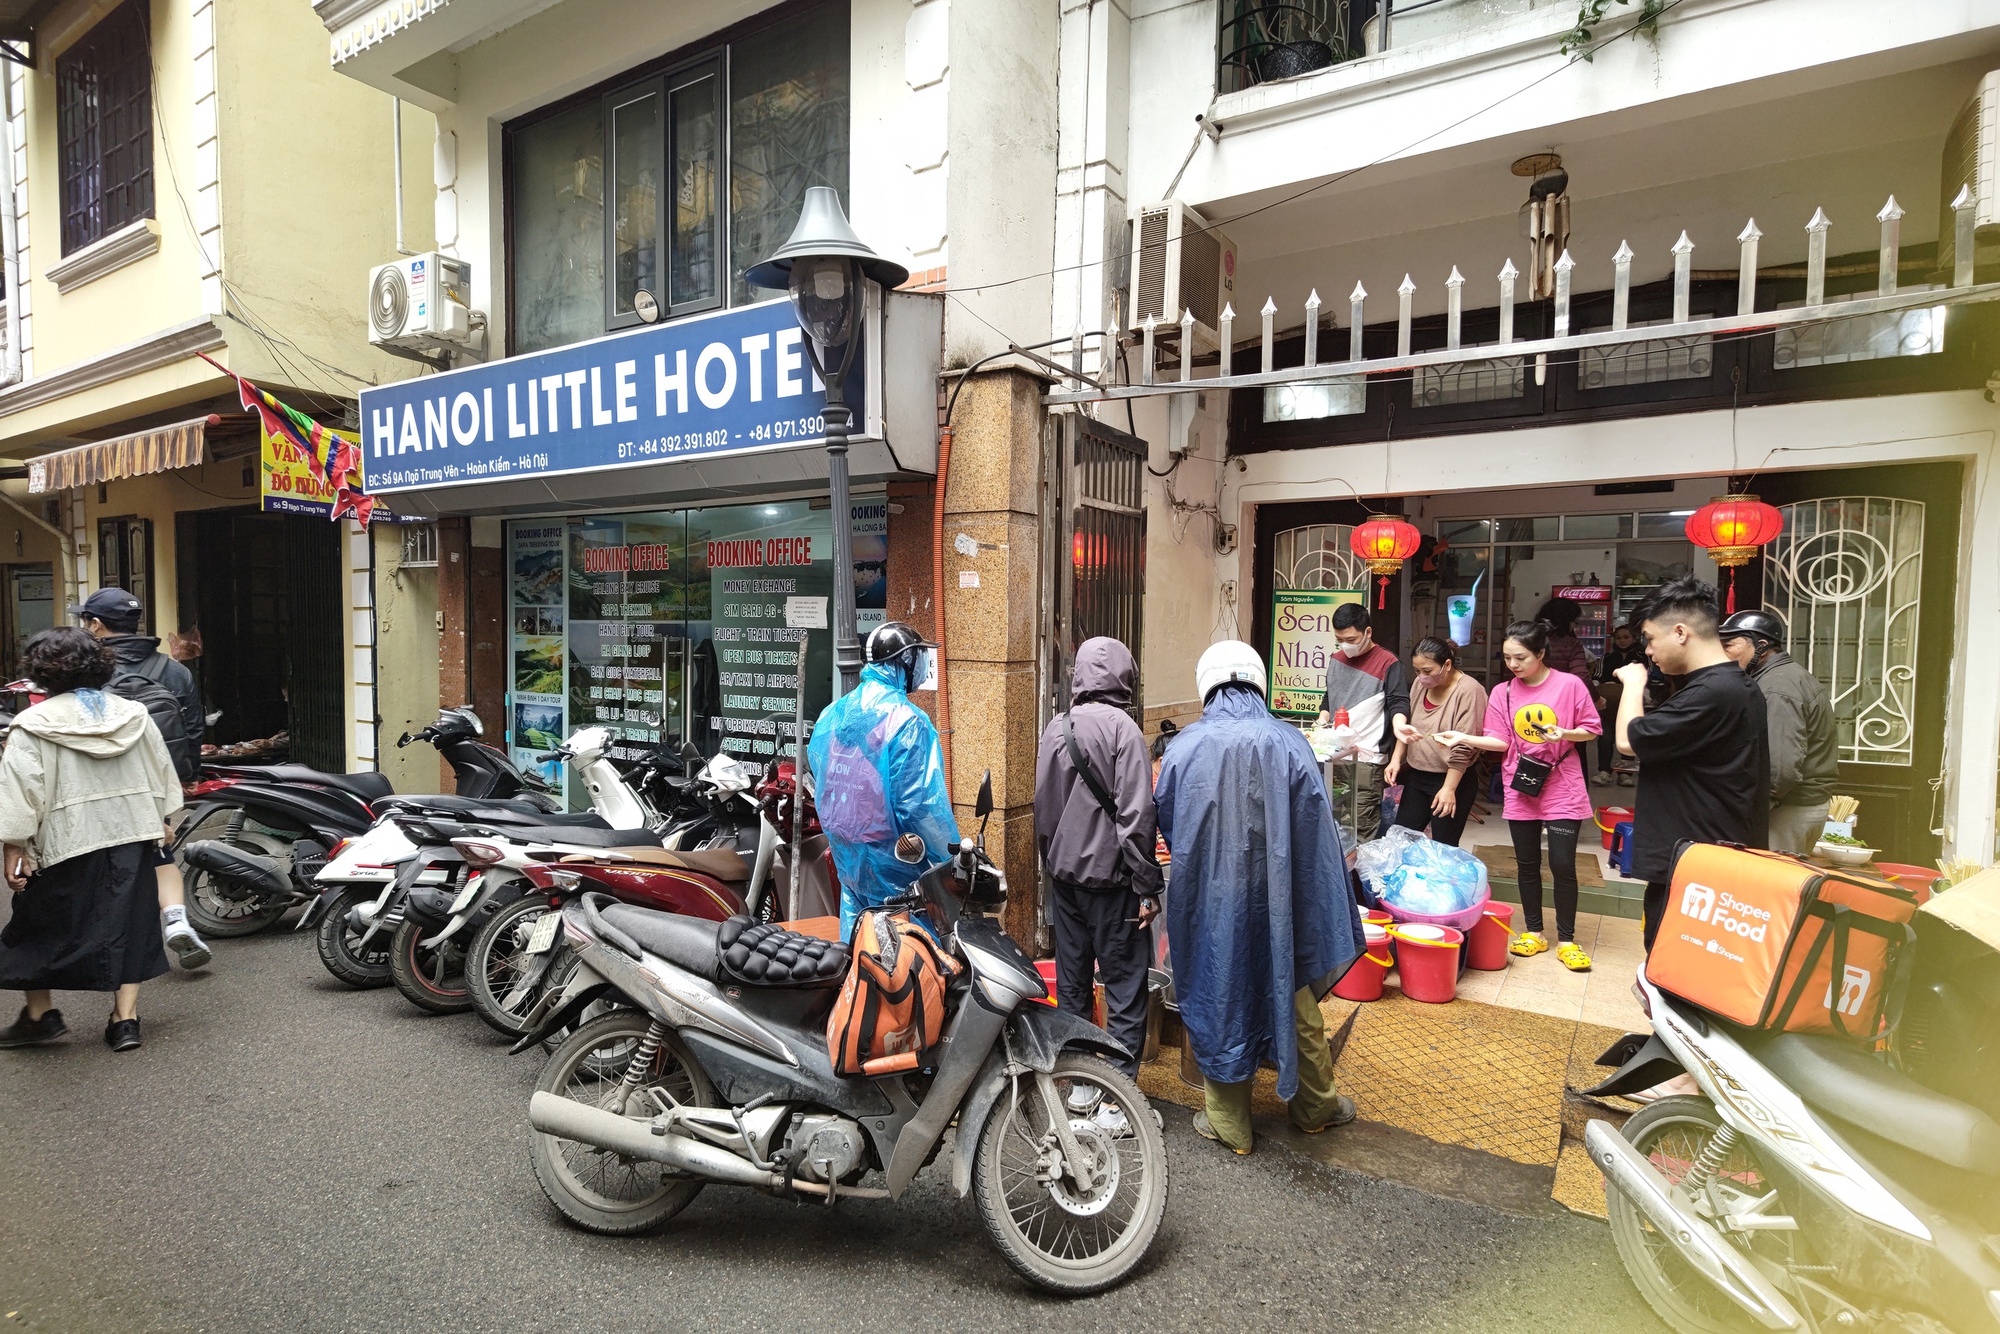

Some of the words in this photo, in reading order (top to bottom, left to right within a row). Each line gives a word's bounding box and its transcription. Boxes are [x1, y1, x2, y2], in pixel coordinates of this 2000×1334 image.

[1224, 276, 1233, 292] LG
[373, 388, 494, 458] HANOI
[507, 359, 637, 438] LITTLE
[618, 443, 636, 458] ĐT:
[638, 441, 657, 454] +84
[660, 429, 728, 452] 392.391.802
[749, 425, 771, 441] +84
[369, 474, 381, 487] ĐC:
[382, 470, 392, 485] Số
[393, 472, 403, 484] 9A
[405, 468, 419, 485] Ngõ
[420, 467, 442, 482] Trung
[444, 464, 459, 478] Yên
[467, 460, 487, 475] Hoàn
[489, 456, 510, 472] Kiếm
[519, 455, 531, 469] Hà
[533, 453, 548, 470] Nội
[271, 466, 292, 492] ĐỒ
[295, 473, 335, 497] DÙNG
[282, 500, 288, 510] 9
[300, 505, 315, 514] Trung
[851, 505, 886, 520] OOKING
[515, 529, 542, 539] BOOKING
[543, 527, 562, 538] OFFICE
[853, 523, 861, 532] HA
[862, 523, 878, 532] LONG
[529, 540, 548, 548] TREKKING
[549, 540, 560, 548] TOUR
[707, 538, 763, 568] BOOKING
[766, 536, 812, 566] OFFICE
[584, 546, 630, 573] BOOKING
[632, 544, 669, 571] OFFICE
[593, 582, 619, 595] HALONG
[620, 581, 634, 594] BAY
[635, 580, 660, 594] CRUISE
[723, 580, 751, 593] MONEY
[753, 579, 796, 593] EXCHANGE
[601, 603, 619, 616] SAPA
[620, 603, 652, 616] TREKKING
[724, 604, 739, 617] SIM
[741, 604, 763, 618] CARD
[764, 604, 776, 618] 4G
[862, 613, 881, 621] ISLAND
[1278, 605, 1331, 632] Sen
[599, 624, 618, 637] HANOI
[620, 624, 635, 636] CITY
[636, 624, 654, 637] TOUR
[715, 627, 741, 641] FLIGHT
[746, 628, 772, 642] TRAIN
[773, 628, 808, 642] TICKETS
[601, 645, 611, 656] HA
[612, 645, 632, 657] GIANG
[633, 645, 651, 657] LOOP
[723, 649, 744, 663] OPEN
[745, 650, 763, 664] BUS
[764, 651, 798, 665] TICKETS
[1276, 640, 1327, 669] Nhã
[591, 666, 605, 678] BAN
[606, 667, 621, 679] GIOC
[622, 667, 661, 680] WATERFALL
[719, 672, 752, 687] AR/TAXI
[754, 673, 765, 688] TO
[767, 674, 799, 689] AIRPOR
[1274, 672, 1310, 688] Nước
[550, 696, 561, 704] TOUR
[590, 686, 603, 699] MAI
[604, 687, 622, 700] CHAU
[627, 689, 642, 701] MOC
[643, 690, 662, 703] CHAU
[723, 694, 760, 709] LAUNDRY
[762, 697, 796, 712] SERVICE
[1295, 703, 1316, 711] 0942
[595, 706, 609, 719] HOA
[610, 708, 619, 720] LU
[624, 709, 639, 721] TAM
[625, 727, 648, 742] TRANG
[649, 730, 660, 743] AN
[1524, 729, 1539, 737] dre
[722, 737, 751, 753] STREET
[752, 739, 774, 755] FOOD
[1718, 892, 1771, 921] Shopee
[1711, 907, 1767, 943] Food
[1717, 946, 1744, 963] Shopee
